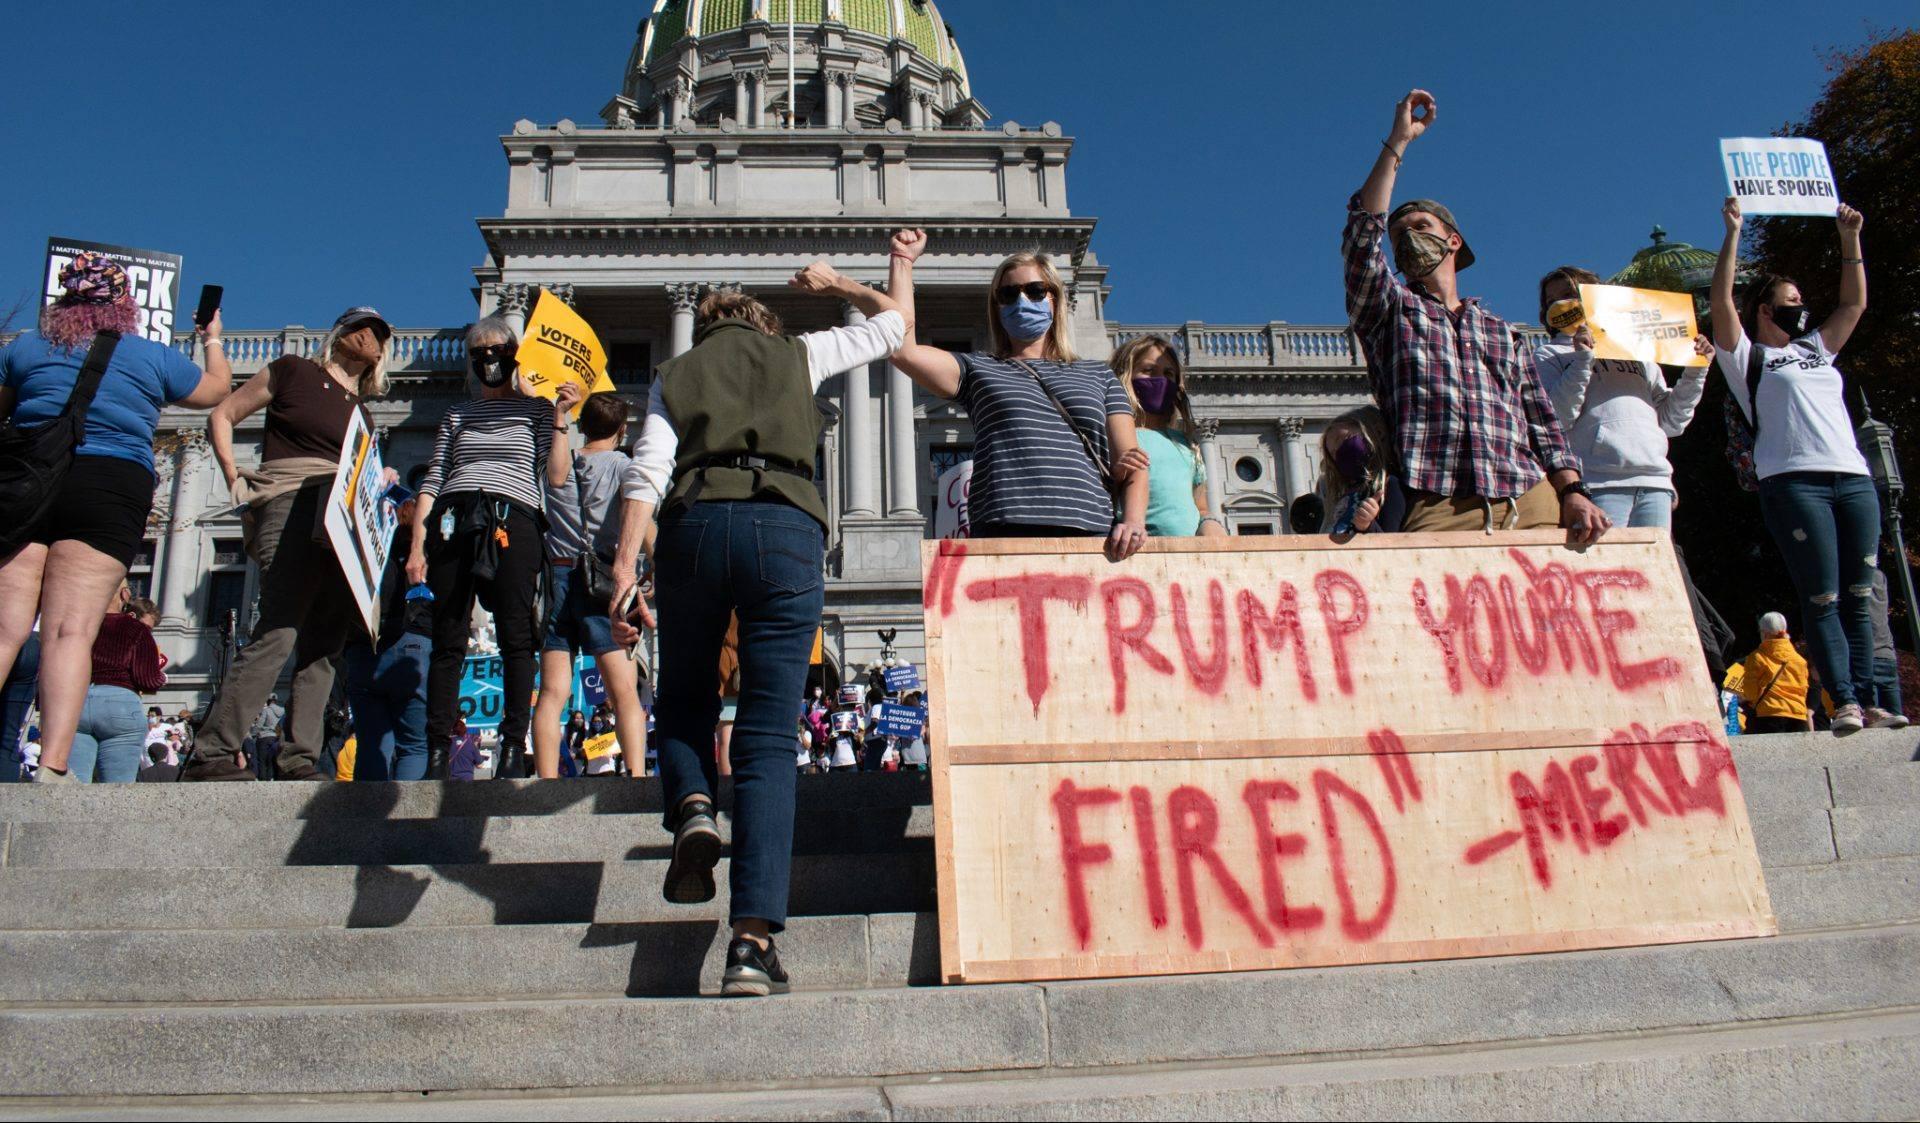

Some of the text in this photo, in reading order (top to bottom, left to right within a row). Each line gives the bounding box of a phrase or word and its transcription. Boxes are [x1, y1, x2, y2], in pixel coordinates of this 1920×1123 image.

[1728, 152, 1829, 178] THE PEOPLE
[1734, 180, 1834, 197] HAVE SPOKEN
[46, 254, 175, 311] BCK
[541, 324, 592, 362] VOTERS
[563, 355, 595, 390] DECIDE
[888, 716, 923, 725] DEMOCRACIA
[889, 709, 917, 718] PROTEGER
